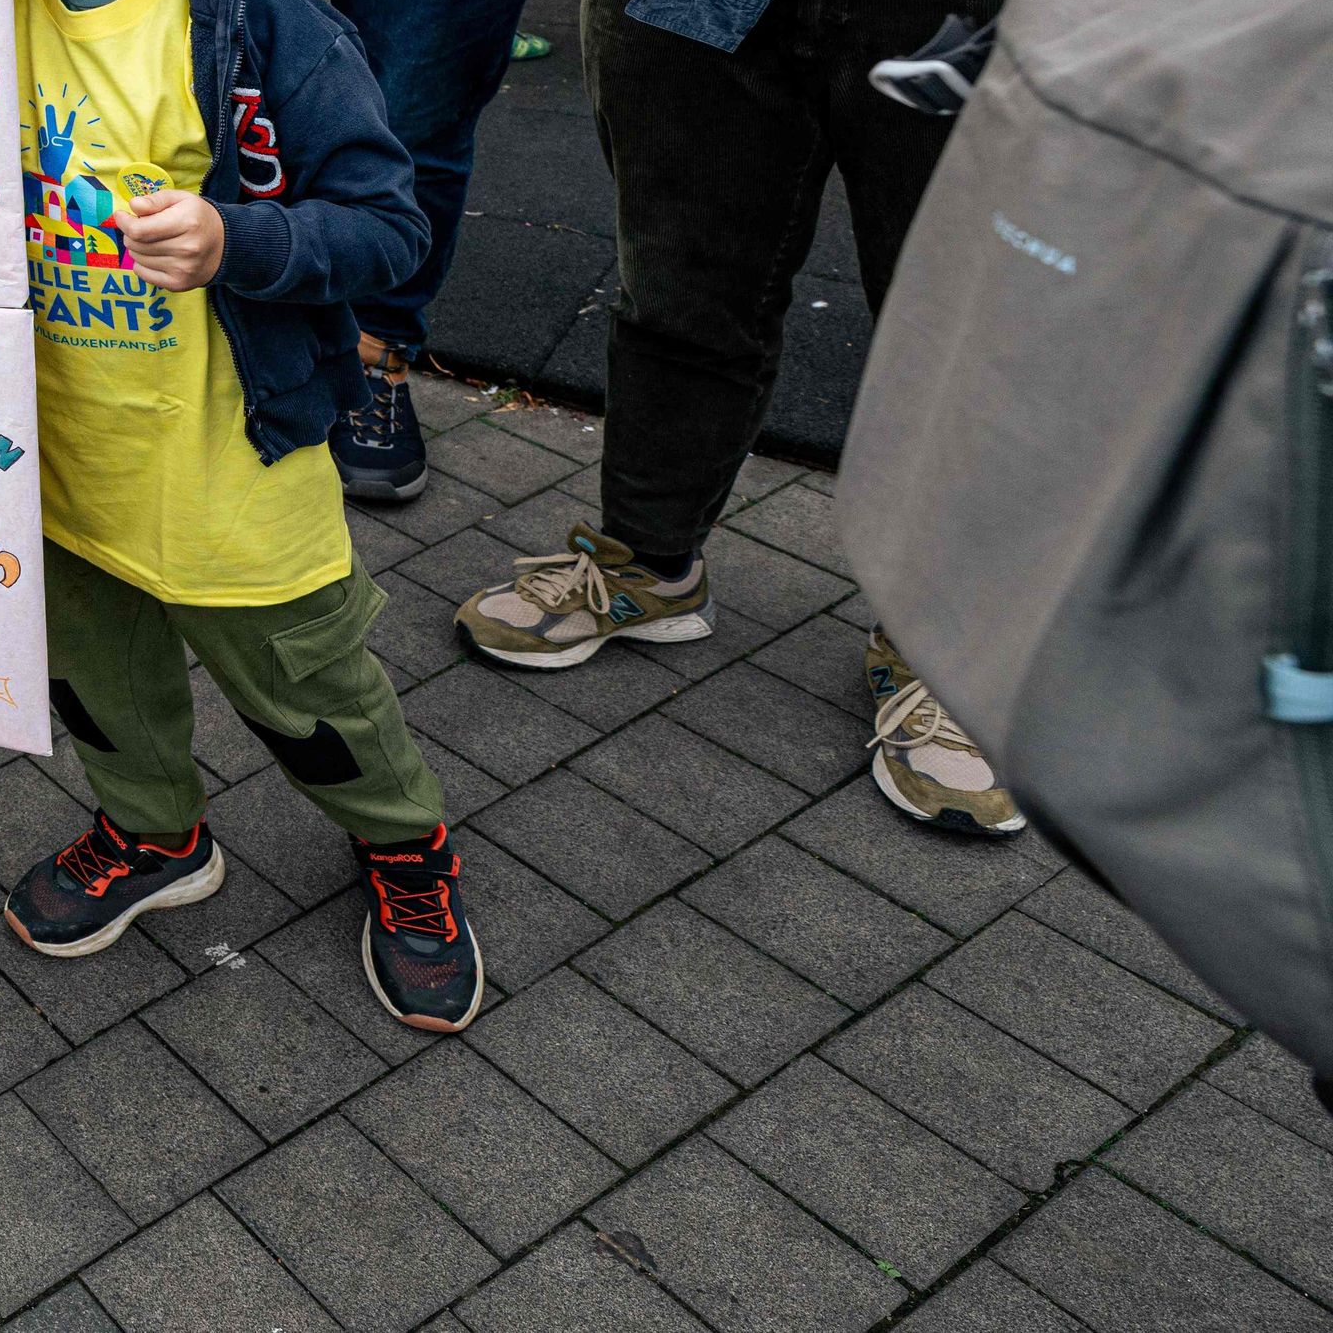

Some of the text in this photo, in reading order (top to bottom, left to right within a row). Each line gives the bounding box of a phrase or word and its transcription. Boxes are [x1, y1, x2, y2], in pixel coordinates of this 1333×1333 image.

[28, 260, 164, 298] ILLE AU
[28, 285, 173, 332] FANTS
[369, 853, 424, 864] KangaROOS
